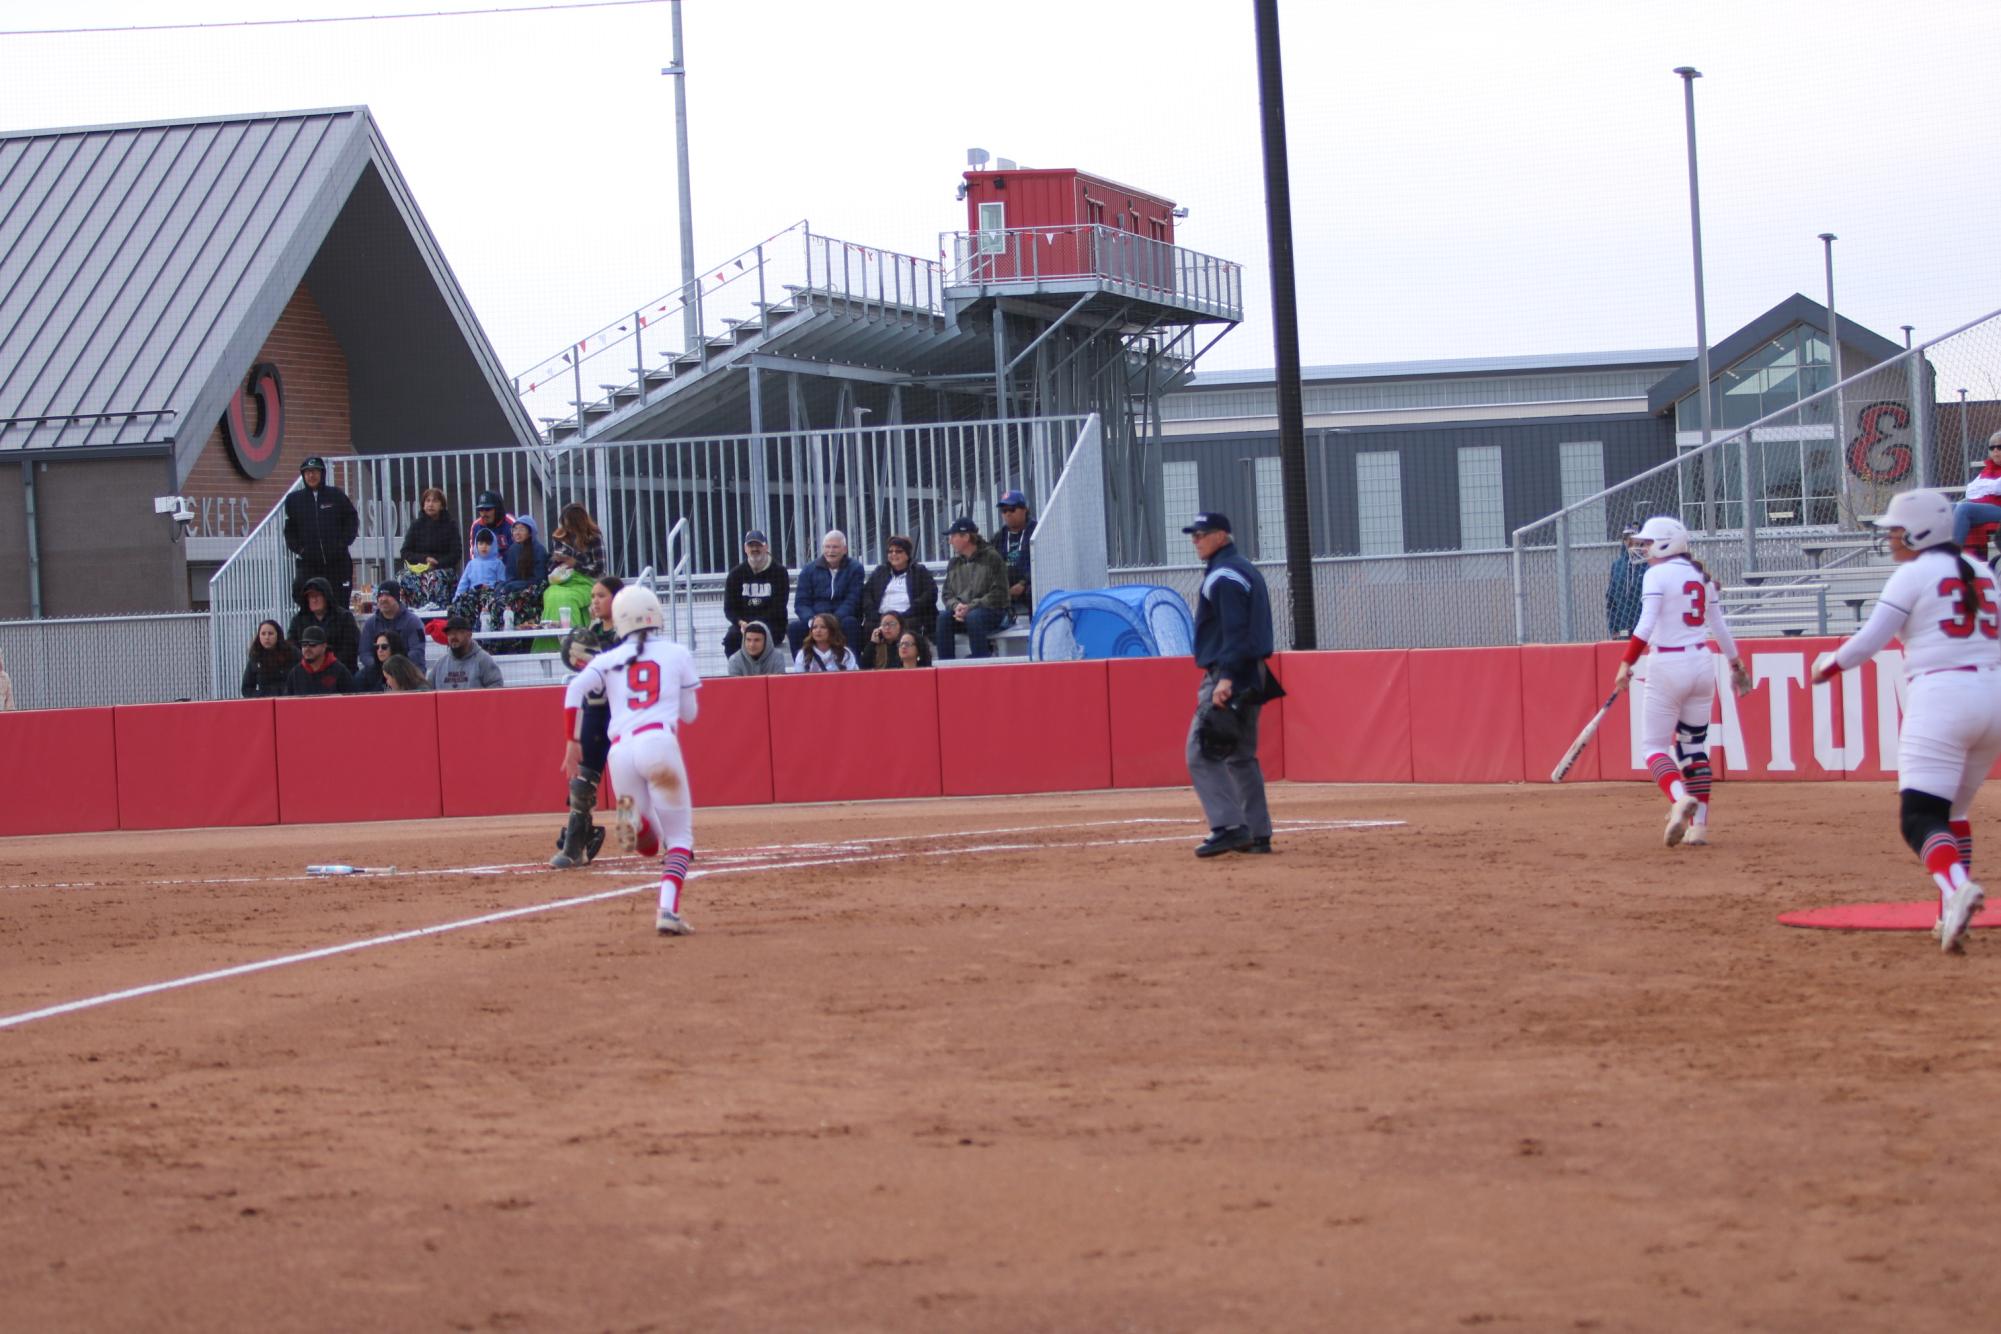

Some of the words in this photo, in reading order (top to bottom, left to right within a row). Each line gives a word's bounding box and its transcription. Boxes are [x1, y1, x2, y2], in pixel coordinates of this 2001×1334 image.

[1683, 581, 1705, 627] 3
[1937, 577, 2000, 639] 35
[627, 660, 660, 711] 9
